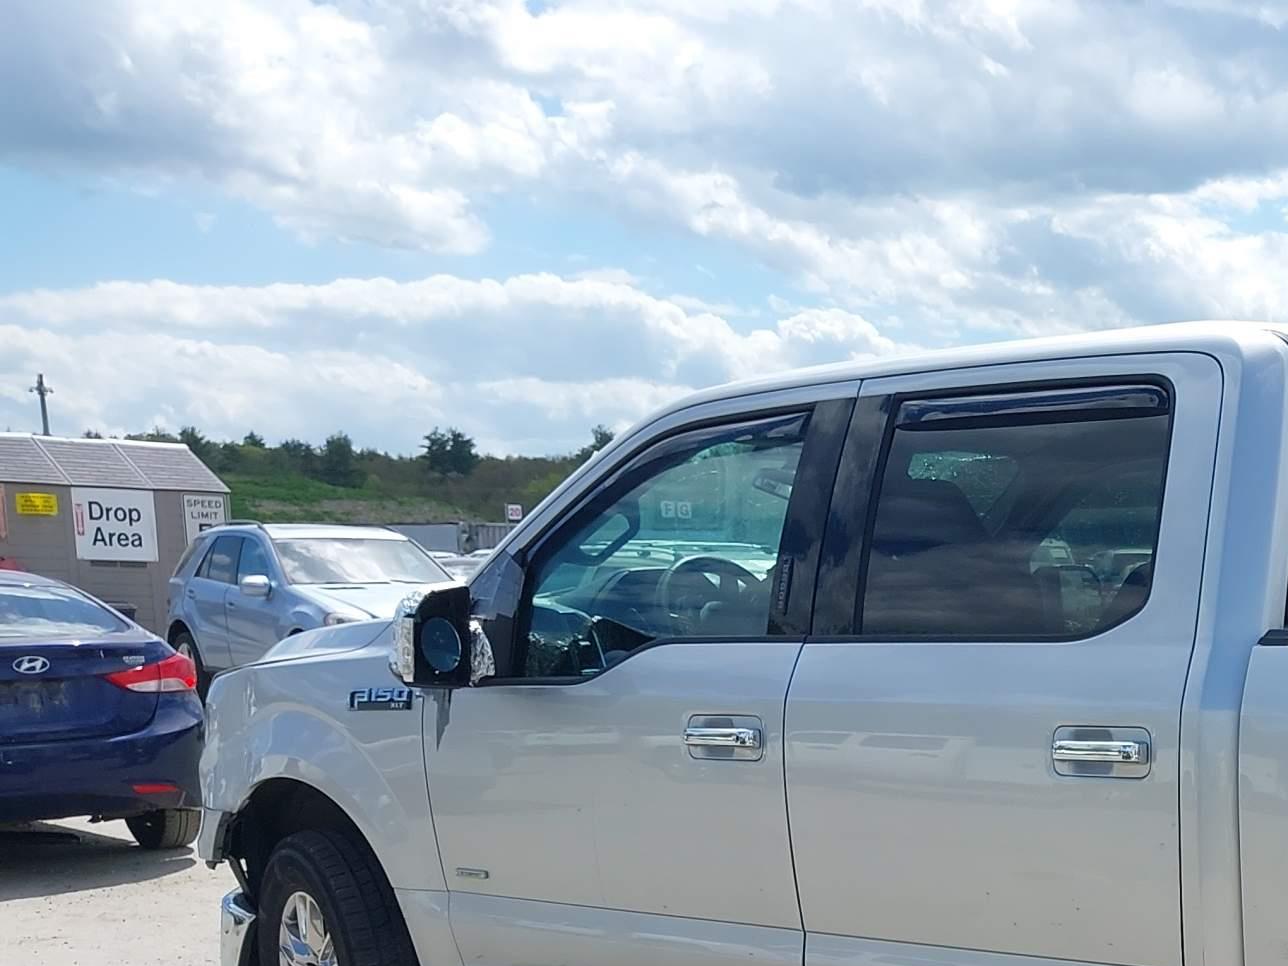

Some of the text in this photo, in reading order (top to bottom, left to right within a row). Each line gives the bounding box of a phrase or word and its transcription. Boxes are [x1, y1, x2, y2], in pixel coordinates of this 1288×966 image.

[186, 499, 222, 509] SPEED
[88, 501, 142, 527] Drop
[190, 511, 219, 520] LIMIT
[92, 526, 143, 548] Area
